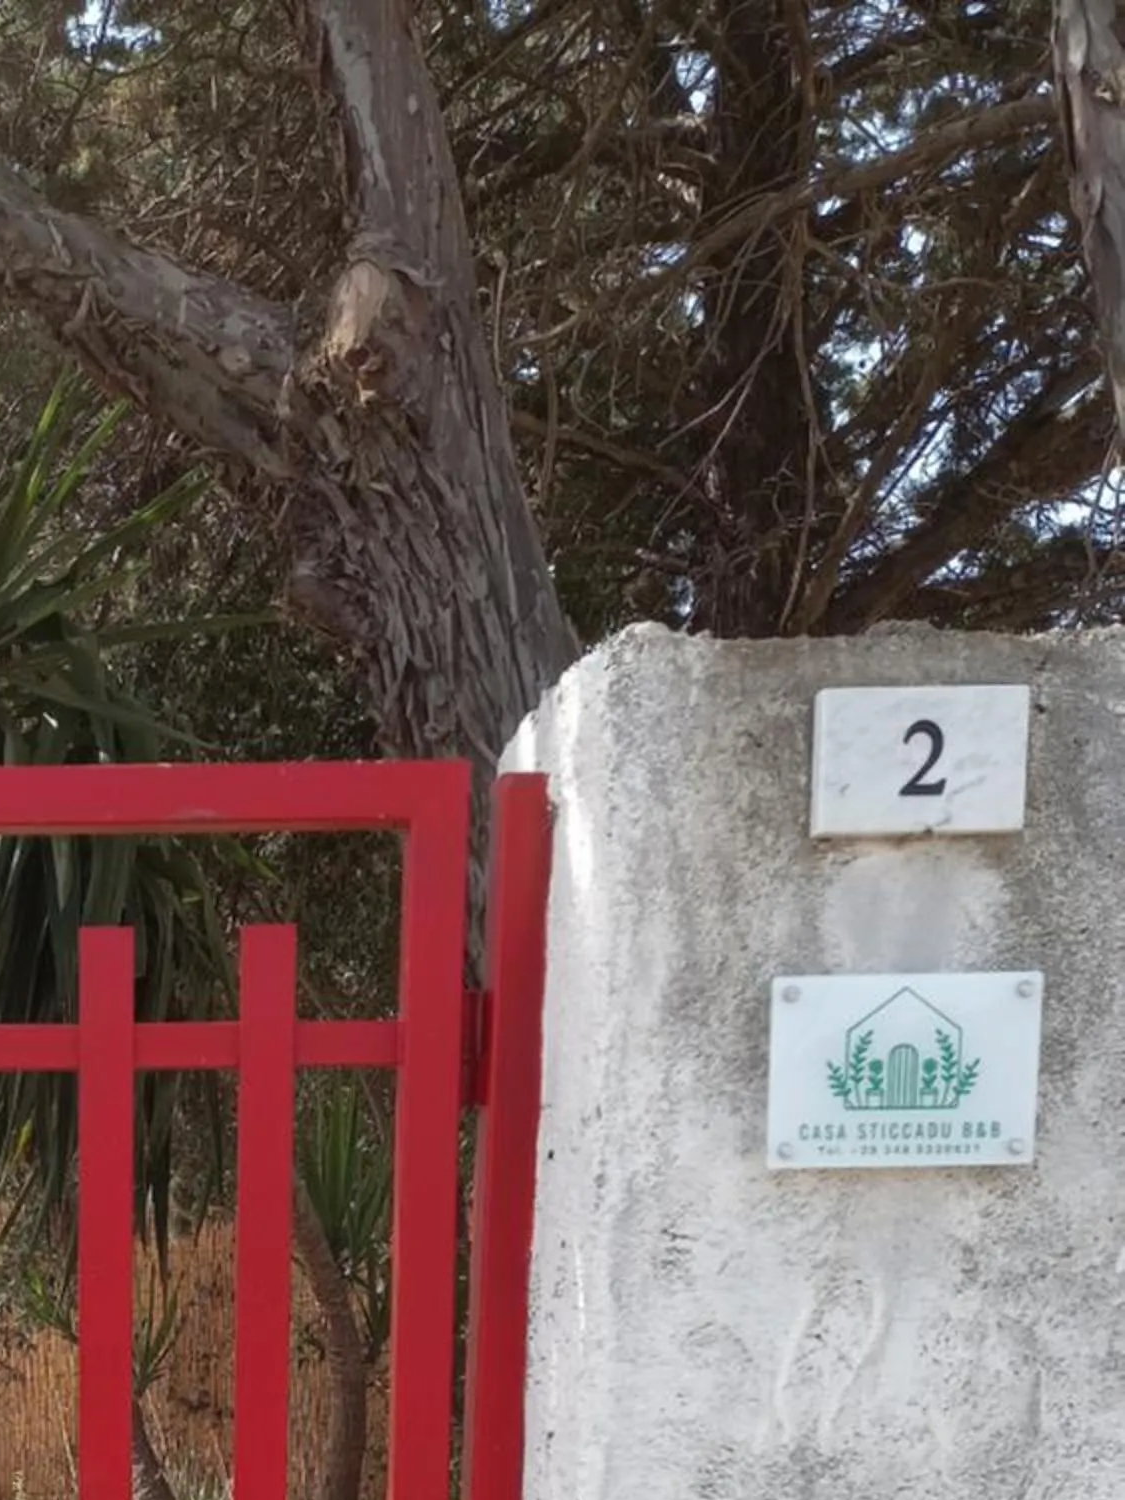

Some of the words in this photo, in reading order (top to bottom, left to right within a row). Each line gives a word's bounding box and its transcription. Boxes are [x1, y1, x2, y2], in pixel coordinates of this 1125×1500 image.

[898, 719, 946, 796] 2
[798, 1122, 847, 1141] CASA
[857, 1120, 953, 1140] STICCADU
[961, 1120, 1002, 1139] B&B
